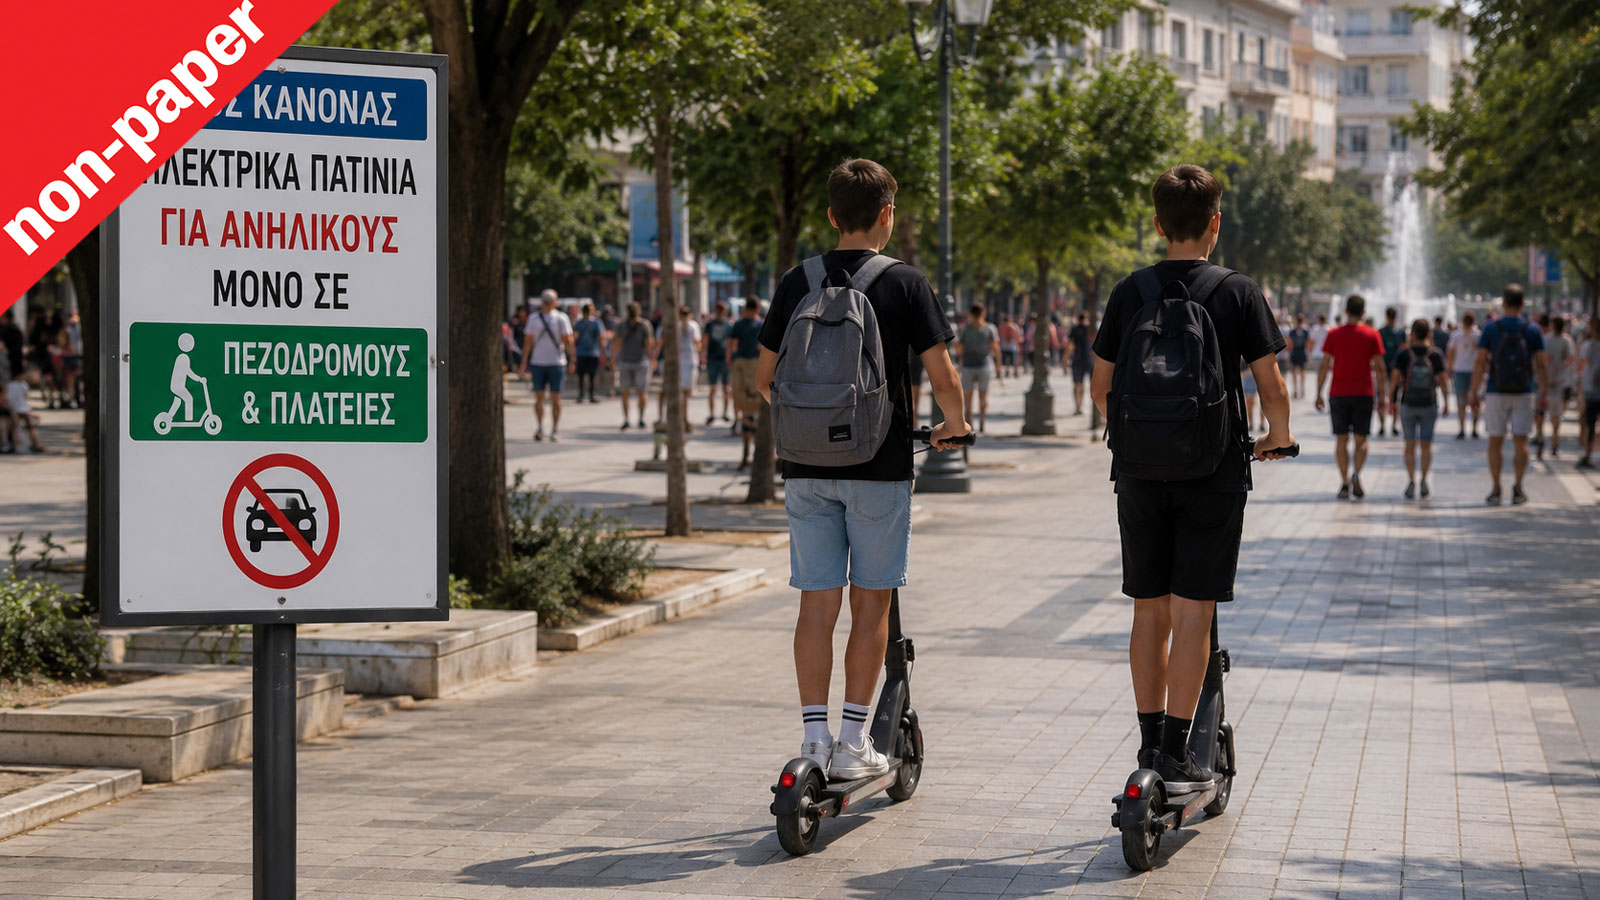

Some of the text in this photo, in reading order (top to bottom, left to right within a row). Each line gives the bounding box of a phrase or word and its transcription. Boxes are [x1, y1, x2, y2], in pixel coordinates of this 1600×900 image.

[254, 84, 398, 127] ΚΑΝΟΝΑΣ
[311, 154, 417, 196] ΠΑΤΙΝΙΑ
[161, 208, 399, 254] ΓΙΑ ΑΝΗΛΙΚΟΥΣ
[213, 270, 349, 310] ΜΟΝΟ ΣΕ
[224, 341, 411, 377] ΠΕΖΟΔΡΟΜΟΥΣ
[241, 391, 396, 426] & ΠΛΑΤΕΙΕΣ
